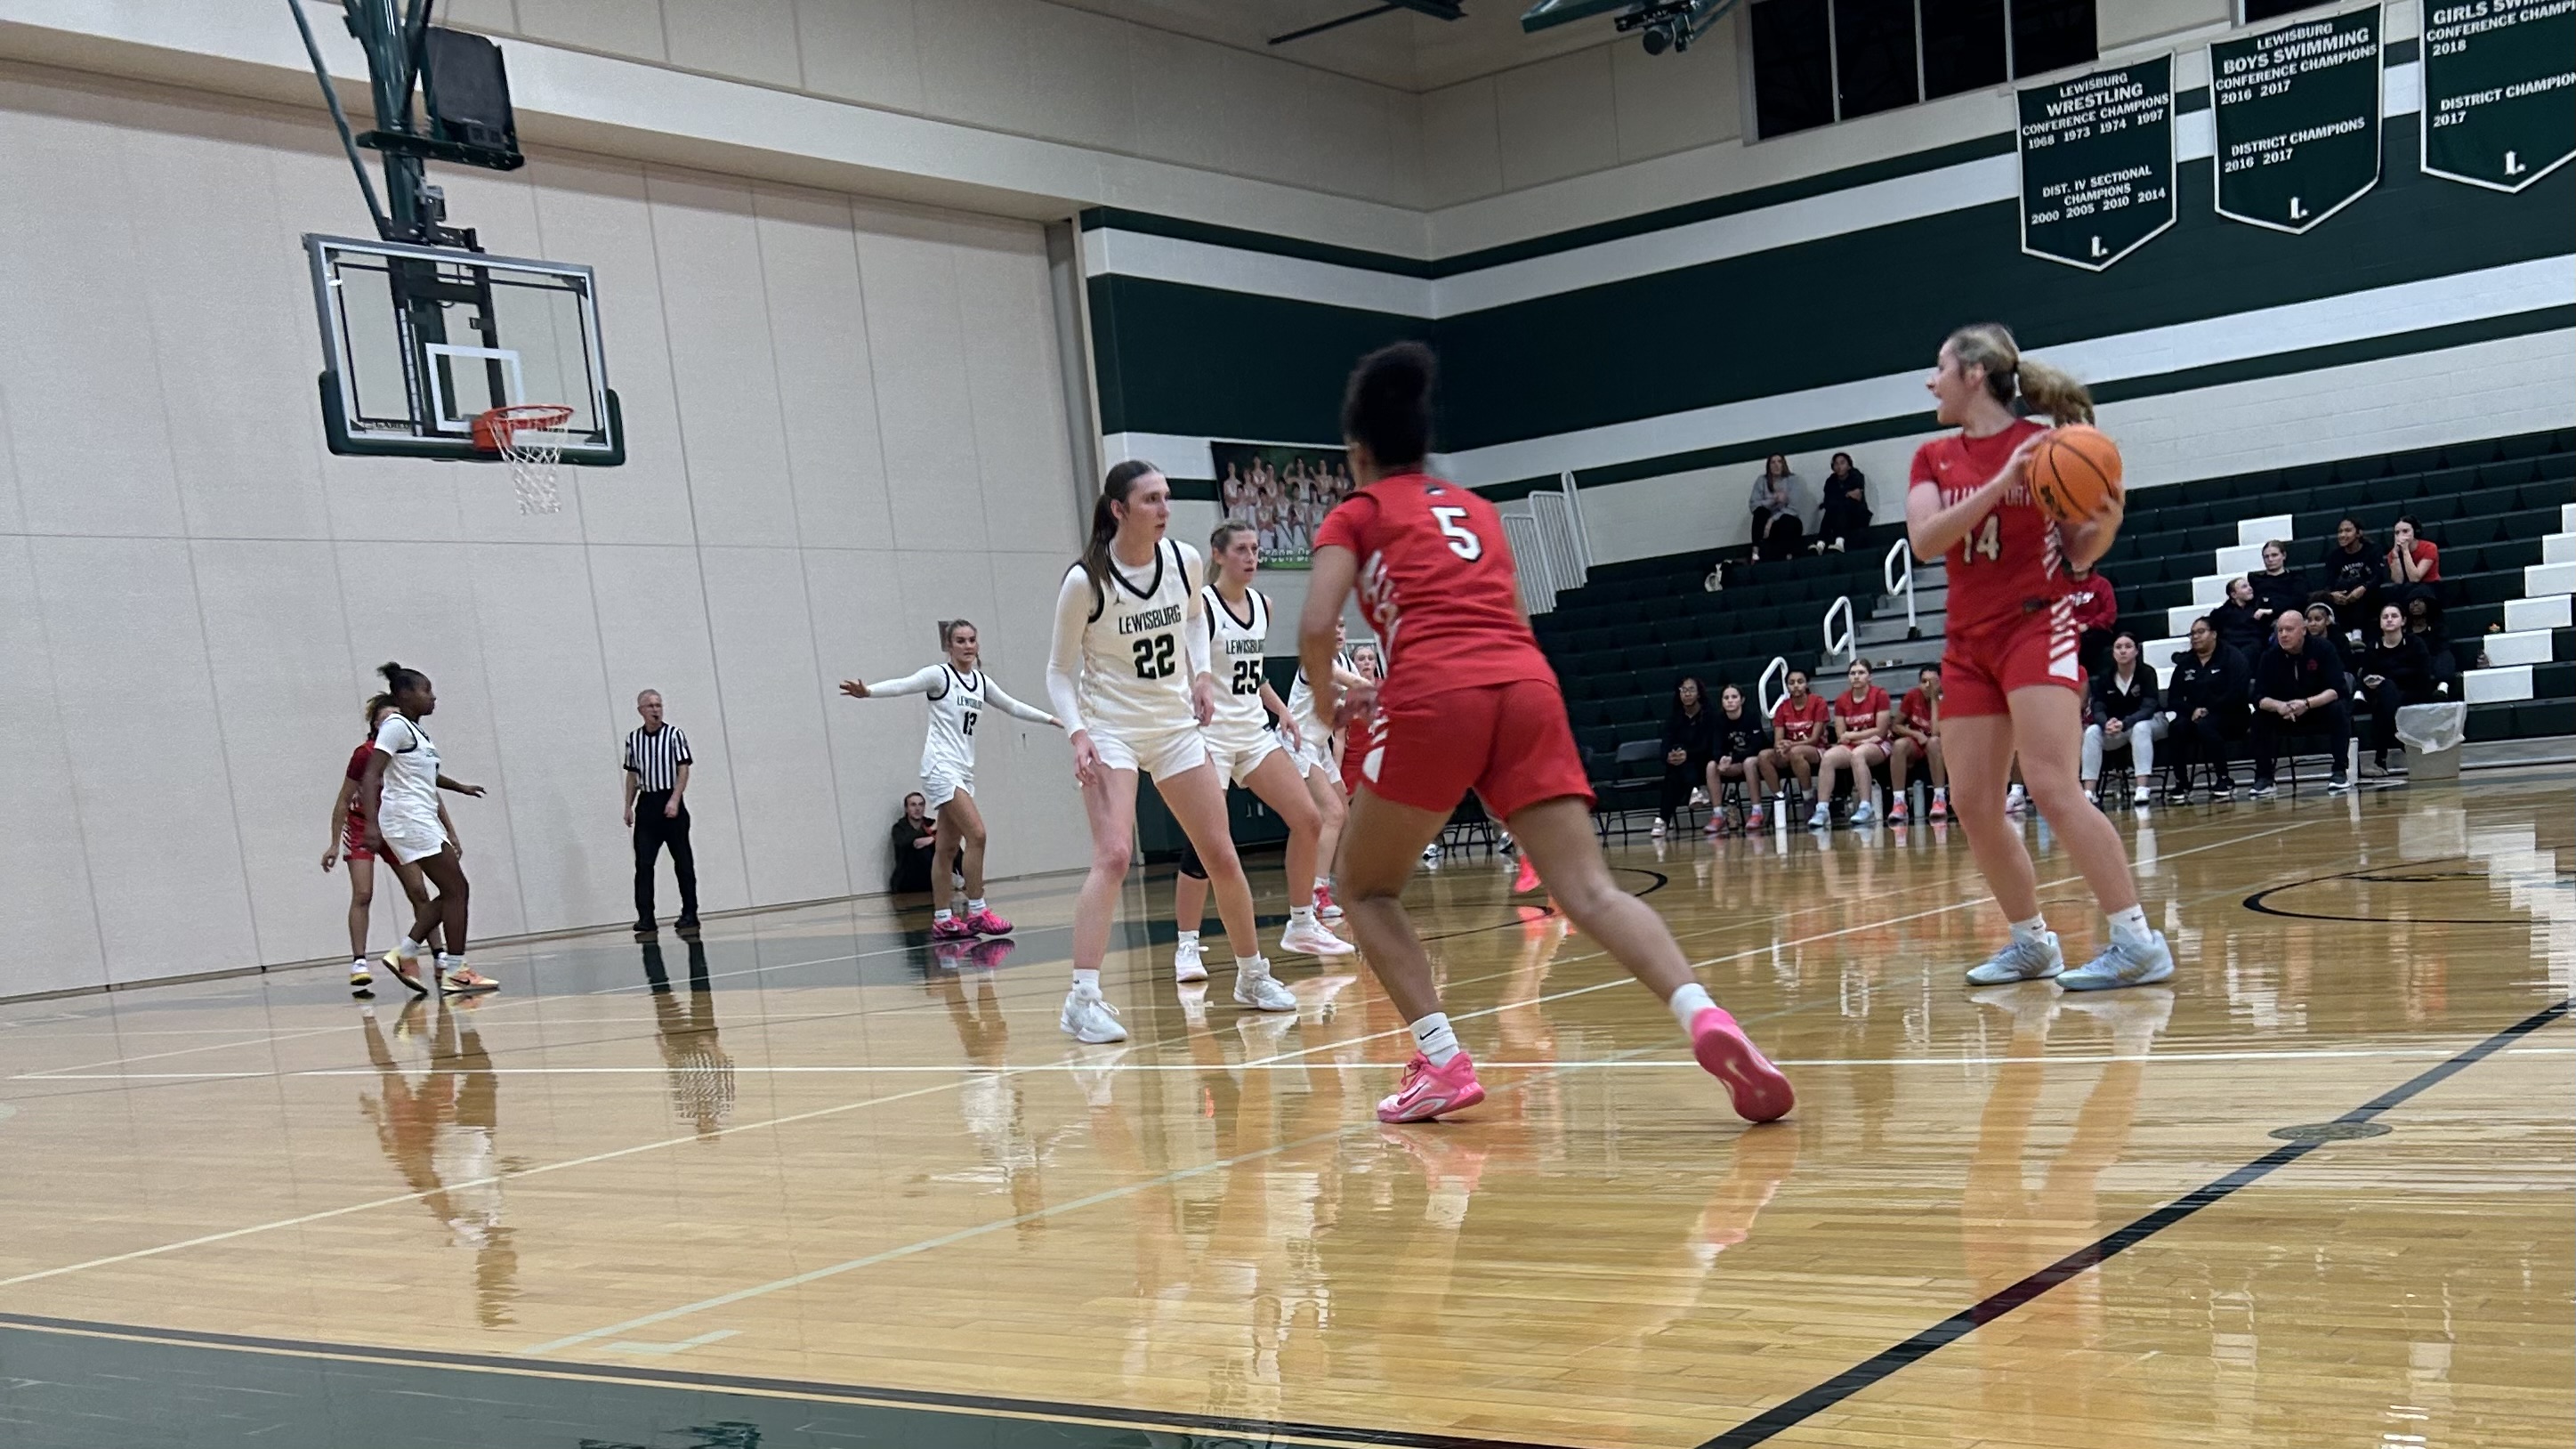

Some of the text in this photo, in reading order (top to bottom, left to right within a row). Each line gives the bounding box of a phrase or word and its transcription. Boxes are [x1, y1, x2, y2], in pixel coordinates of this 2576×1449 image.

[2426, 12, 2517, 42] CONFERENCE
[2519, 0, 2576, 22] CHAMPI
[2433, 1, 2489, 25] GIRLS
[2223, 27, 2370, 75] BOYS SWIMMING
[2257, 22, 2333, 51] LEWISBURG
[2432, 38, 2467, 57] 2018
[2215, 43, 2378, 91] CONFERENCE CHAMPIONS
[2046, 82, 2144, 117] WRESTLING
[2059, 72, 2128, 98] LEWISBURG
[2220, 78, 2291, 105] 2016 2017
[2440, 71, 2576, 111] DISTRICT CHAMPION
[2022, 93, 2169, 136] CONFERENCE CHAMPIONS
[2028, 109, 2164, 150] 1968 1973 1974 1997
[2433, 110, 2467, 128] 2017
[2231, 117, 2366, 158] DISTRICT CHAMPIONS
[2225, 148, 2294, 173] 2016 2017
[2042, 165, 2152, 198] DIST. IV SECTIONAL
[2063, 182, 2131, 206] CHAMPIONS
[2031, 187, 2166, 225] 2000 2005 2010 2014
[1430, 505, 1483, 563] 5
[1963, 514, 2000, 564] 14
[1118, 604, 1182, 635] LEWISBURG
[1133, 634, 1176, 680] 22
[1225, 638, 1264, 655] LEWISBU
[1231, 660, 1260, 695] 25
